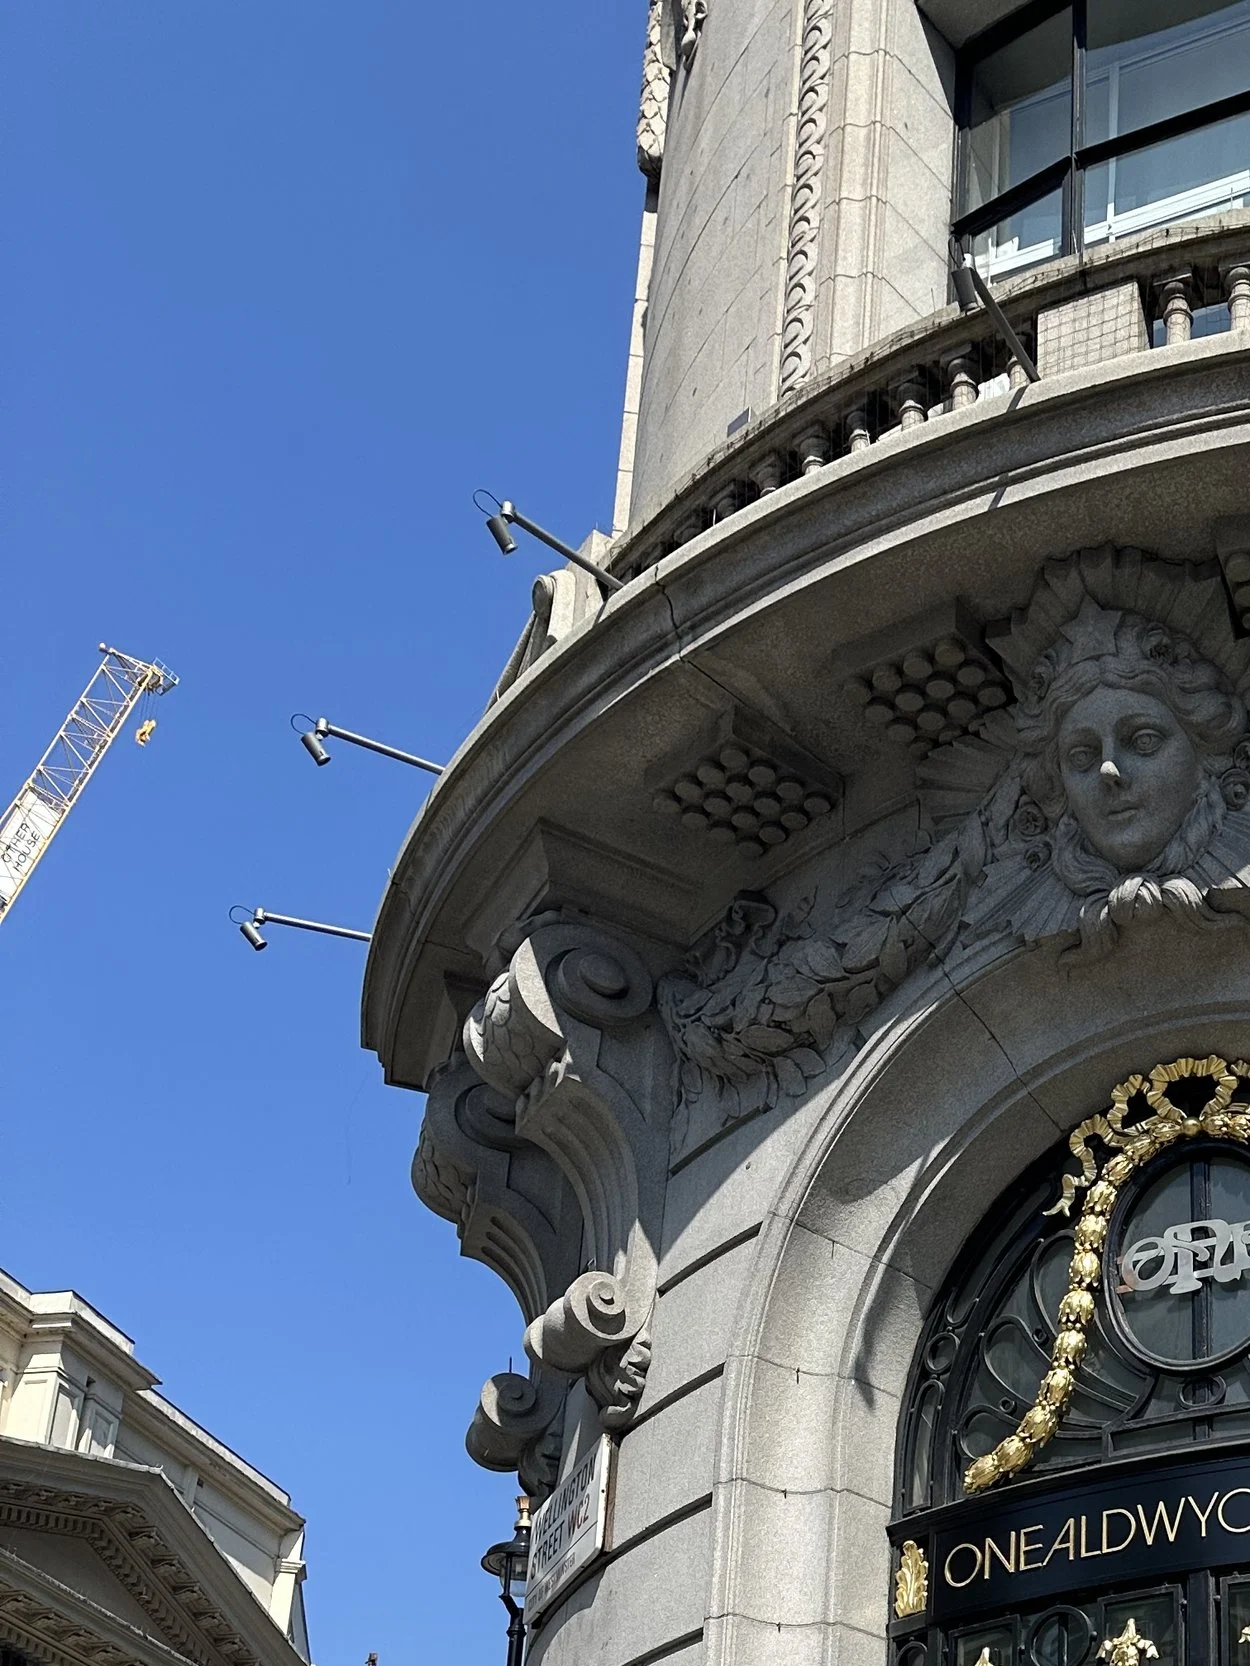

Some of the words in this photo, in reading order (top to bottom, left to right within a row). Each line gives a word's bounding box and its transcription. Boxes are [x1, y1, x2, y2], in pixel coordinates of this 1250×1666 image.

[13, 830, 41, 873] HOUSE
[530, 1518, 566, 1580] STREET
[567, 1493, 590, 1541] WC2
[533, 1453, 597, 1543] WELLINGTON
